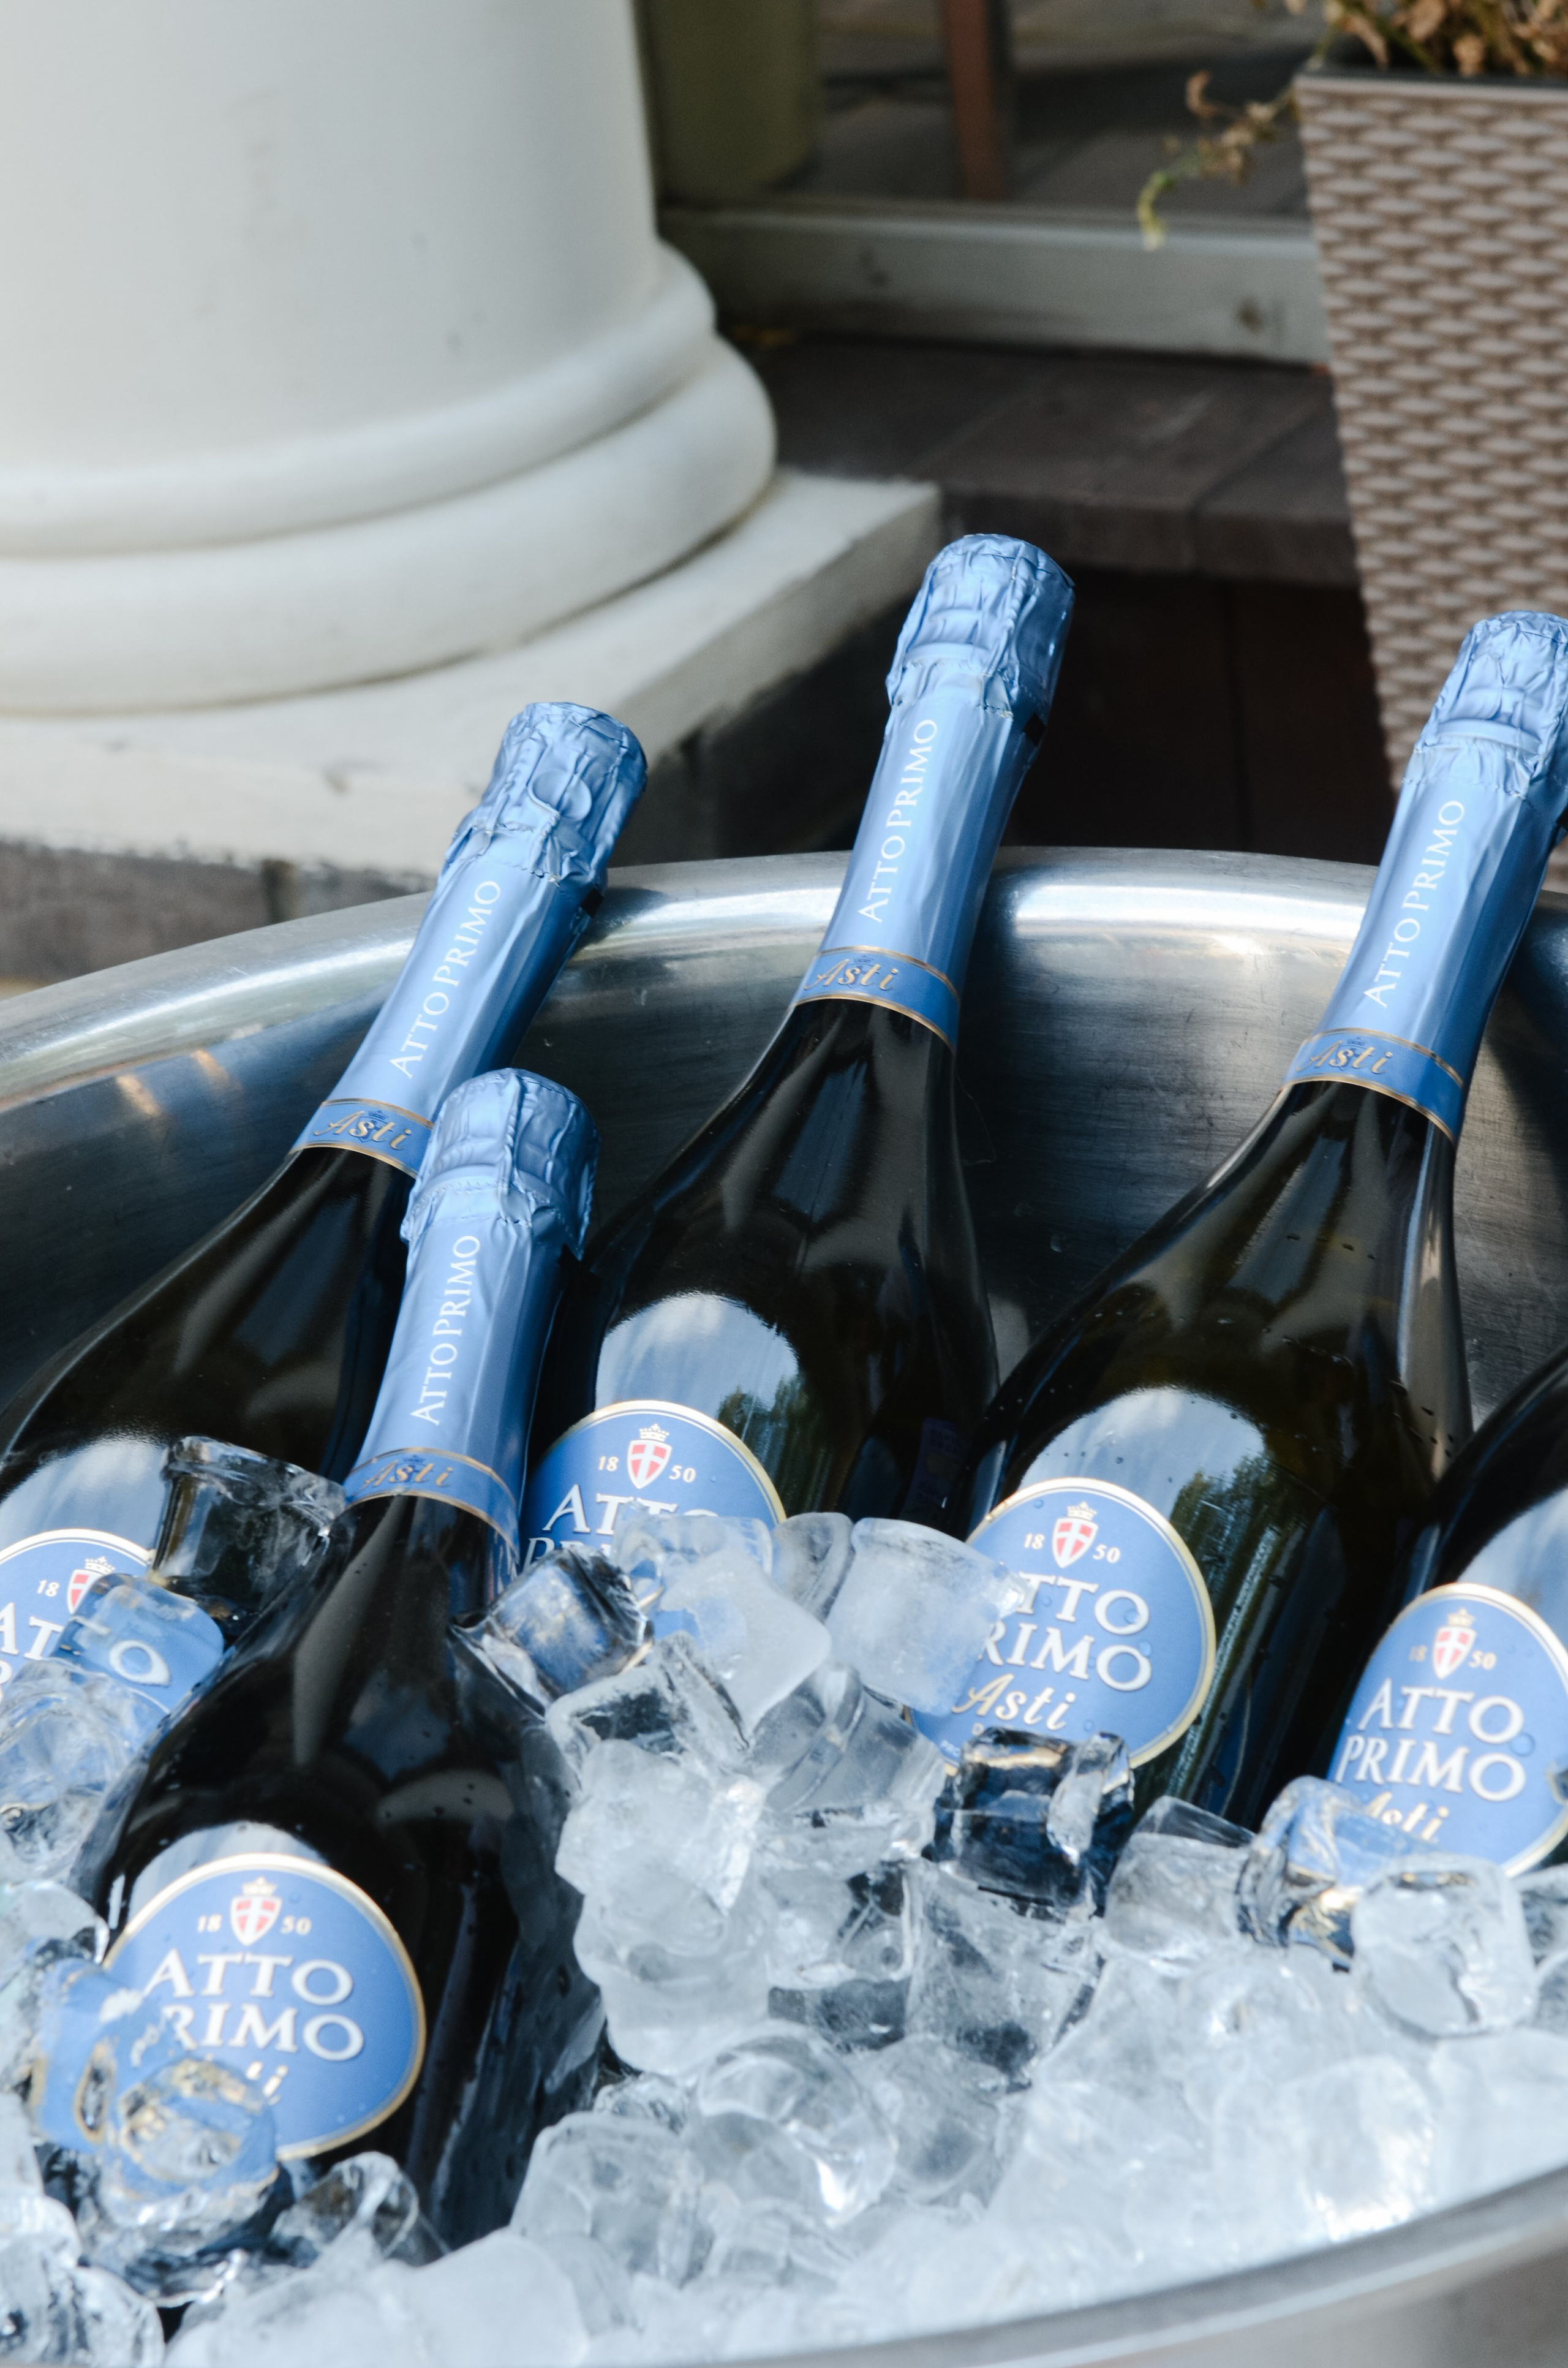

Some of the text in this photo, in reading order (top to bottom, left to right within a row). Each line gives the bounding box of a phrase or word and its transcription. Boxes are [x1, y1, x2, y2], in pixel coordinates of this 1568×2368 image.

[858, 719, 938, 923] ATTO PRIMO
[1363, 800, 1465, 1008] ATTO PRIMO
[389, 880, 502, 1080] ATTO PRIMO
[804, 957, 899, 992] Asti
[1295, 1039, 1393, 1075] Asti
[314, 1110, 413, 1151] Asti
[410, 1235, 481, 1426] ATTO PRIMO
[361, 1459, 454, 1488] Asti
[598, 1455, 696, 1483] 18 50
[542, 1483, 719, 1535] AT
[1023, 1533, 1121, 1564] 18 50
[37, 1579, 60, 1597] 18
[1015, 1571, 1150, 1636] TTO
[978, 1618, 1152, 1692] RIMO
[1468, 1650, 1497, 1671] 50
[951, 1673, 1076, 1731] Asti
[1357, 1677, 1525, 1744] ATTO
[1334, 1734, 1526, 1802] PRIMO
[197, 1913, 312, 1936] 18 50
[141, 1947, 353, 2006] ATTO
[161, 2002, 364, 2062] RIMO
